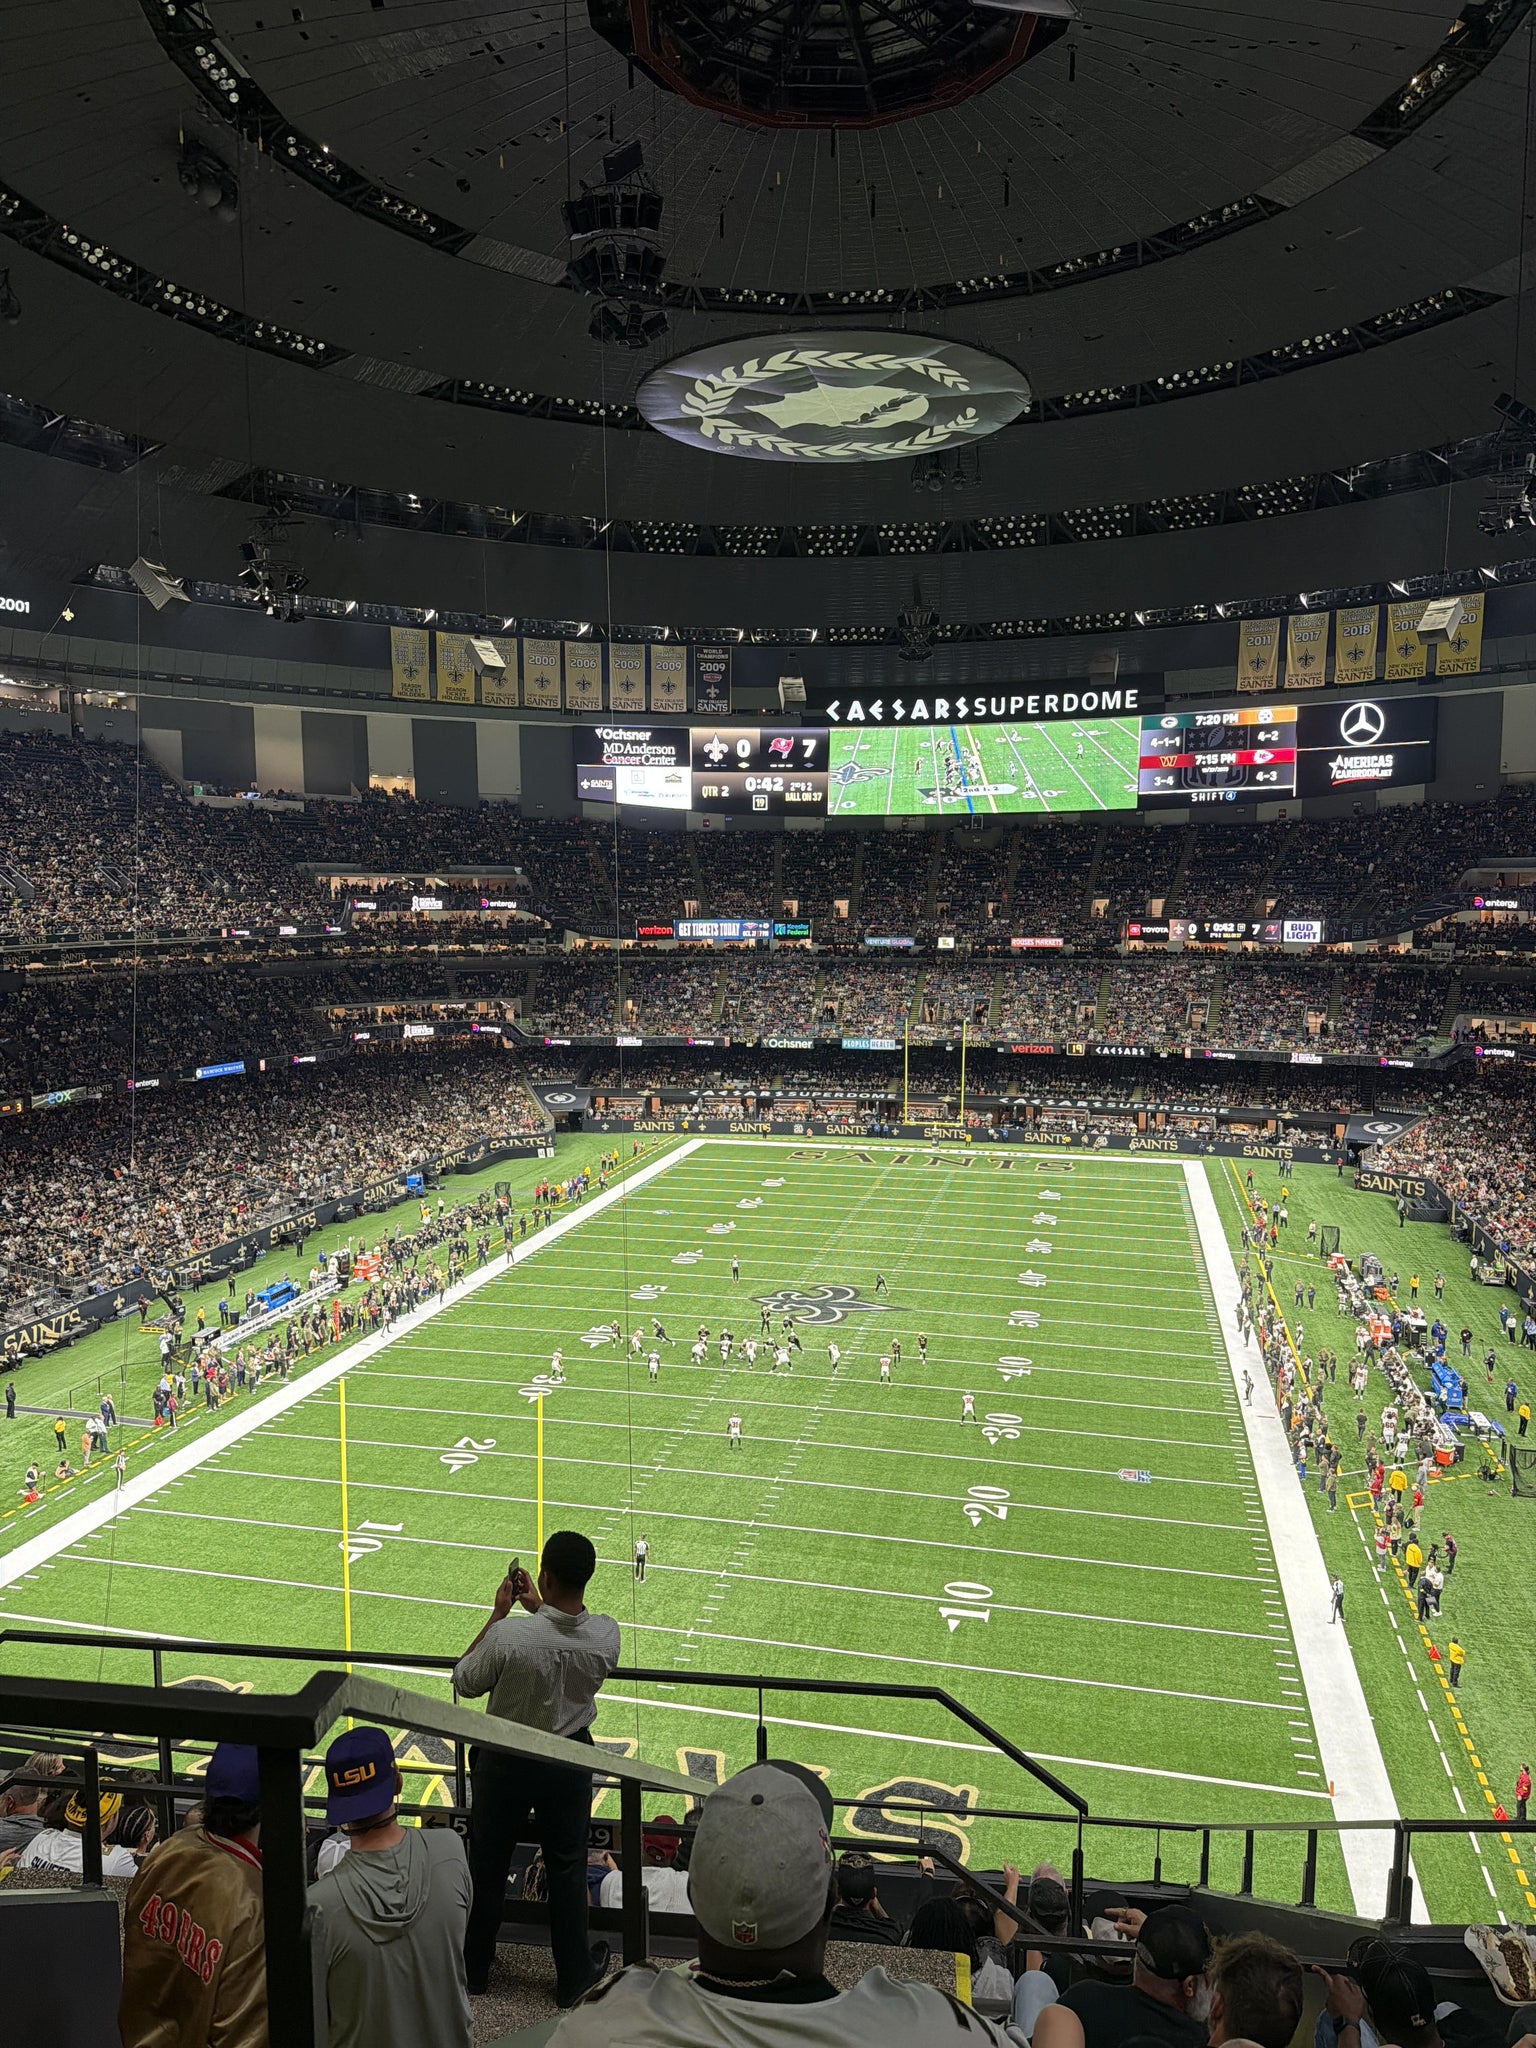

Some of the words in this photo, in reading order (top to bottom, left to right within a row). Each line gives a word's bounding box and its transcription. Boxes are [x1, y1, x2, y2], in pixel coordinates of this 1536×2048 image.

[1295, 631, 1320, 642] 2017
[1343, 625, 1370, 638] 2018
[1247, 636, 1271, 646] 2011
[528, 654, 556, 666] 2000
[570, 658, 597, 668] 2006
[614, 660, 640, 670] 2009
[656, 661, 682, 671] 2009
[700, 662, 726, 672] 2009
[1438, 662, 1477, 673] SAINTS
[1337, 670, 1373, 681] SAINTS
[1388, 667, 1424, 678] SAINTS
[1240, 678, 1274, 688] SAINTS
[1288, 676, 1322, 686] SAINTS
[484, 697, 516, 706] SAINTS
[526, 698, 559, 707] SAINTS
[568, 700, 600, 710] SAINTS
[612, 700, 643, 710] SAINTS
[654, 702, 684, 710] SAINTS
[826, 697, 968, 721] CAESARS
[974, 690, 1138, 716] SUPERDOME
[697, 703, 728, 712] SAINTS
[1196, 714, 1220, 726] 7:20
[1223, 714, 1238, 724] PM
[602, 728, 652, 740] Ochsner
[1258, 730, 1279, 742] 4-2
[1150, 736, 1180, 748] 4-1-1
[603, 742, 624, 754] MD
[624, 744, 676, 754] Anderson
[736, 739, 750, 758] 0
[802, 739, 816, 758] 7
[602, 754, 641, 765] Cancer
[642, 754, 676, 766] Center
[1195, 754, 1218, 766] 7:15
[1220, 753, 1236, 764] PM
[1329, 754, 1394, 769] AMERICAS
[1154, 776, 1174, 786] 3-4
[1256, 770, 1278, 782] 4-3
[746, 776, 784, 792] 0:42
[806, 782, 812, 792] 2
[702, 786, 718, 798] QTR
[722, 786, 730, 797] 2
[785, 792, 800, 802] BALL
[802, 792, 812, 802] ON
[812, 792, 822, 802] 37
[756, 798, 764, 808] 19
[490, 900, 516, 908] entergy
[1485, 900, 1518, 908] entergy
[638, 926, 672, 934] verizon
[678, 923, 691, 936] GET
[692, 923, 718, 936] TICKETS
[720, 923, 740, 936] TODAY
[1188, 924, 1198, 934] 0
[1213, 924, 1234, 932] 0:42
[1252, 924, 1260, 935] 7
[1291, 923, 1314, 932] BUD
[79, 932, 104, 941] SAINTS
[134, 931, 158, 940] SAINTS
[187, 930, 210, 938] SAINTS
[1286, 931, 1318, 940] LIGHT
[19, 936, 46, 944] SAINTS
[322, 940, 346, 948] SAINTS
[1466, 942, 1496, 950] SAINTS
[2, 955, 30, 966] SAINTS
[61, 952, 86, 962] SAINTS
[768, 1039, 813, 1049] Ochsner
[843, 1039, 870, 1048] PEOPLES
[871, 1039, 894, 1048] HEALTH
[1010, 1044, 1054, 1054] verizon
[1072, 1044, 1082, 1054] 19
[1095, 1046, 1146, 1056] CAESARS
[1484, 1048, 1514, 1058] entergy
[1388, 1060, 1414, 1068] entergy
[136, 1078, 160, 1088] entergy
[88, 1084, 113, 1094] SAINTS
[788, 1091, 897, 1099] SUPERDOME
[16, 1102, 22, 1112] 3
[999, 1097, 1102, 1108] CAESARS
[1106, 1102, 1230, 1114] SUPERDOME
[634, 1122, 675, 1132] SAINTS
[730, 1122, 771, 1134] SAINTS
[826, 1124, 868, 1135] SAINTS
[490, 1136, 546, 1149] SAINTS
[1132, 1138, 1178, 1150] SAINTS
[1243, 1146, 1294, 1158] SAINTS
[436, 1150, 466, 1172] SAINTS
[787, 1150, 1076, 1173] SAINTS
[364, 1178, 400, 1200] SAINTS
[1360, 1173, 1426, 1196] SAINTS
[270, 1213, 316, 1245] SAINTS
[1026, 1241, 1052, 1254] 30
[1018, 1272, 1047, 1288] 40
[630, 1284, 668, 1300] 50
[1008, 1310, 1040, 1328] 50
[4, 1307, 82, 1352] SAINTS
[996, 1356, 1032, 1377] 40
[982, 1412, 1022, 1440] 30
[440, 1436, 496, 1465] 20
[962, 1486, 1010, 1520] 20
[338, 1520, 404, 1552] 10
[938, 1581, 994, 1624] 10
[333, 1762, 376, 1788] LSU
